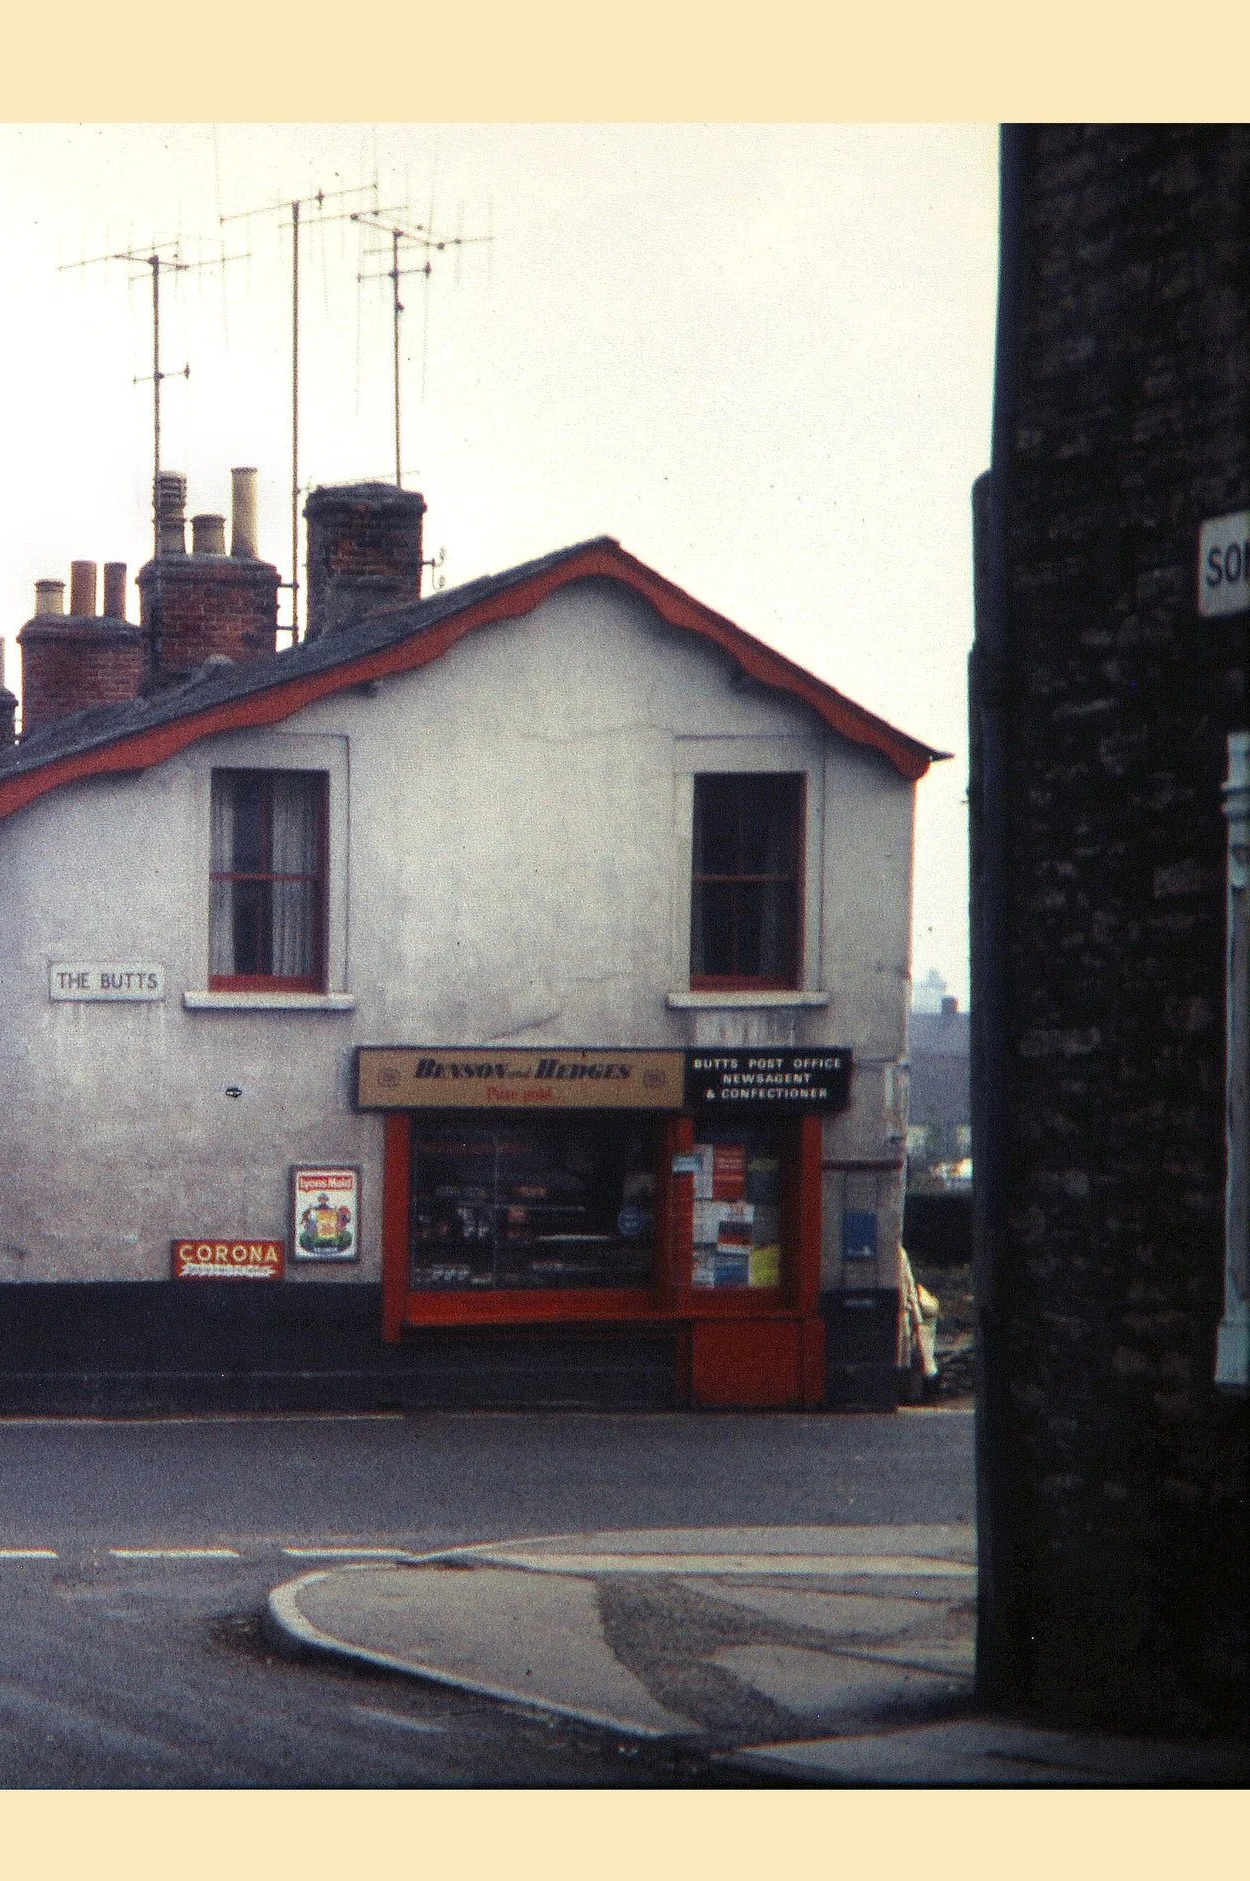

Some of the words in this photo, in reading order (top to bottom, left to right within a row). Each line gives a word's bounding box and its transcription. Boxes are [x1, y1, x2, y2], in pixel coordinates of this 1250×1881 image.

[57, 972, 90, 989] THE
[100, 972, 159, 989] BUTTS
[415, 1058, 509, 1079] BENSON
[534, 1058, 631, 1079] HEDGES
[693, 1058, 738, 1069] BUTTS
[749, 1058, 784, 1069] POST
[793, 1058, 842, 1069] OFFICE
[722, 1072, 811, 1084] NEWSAGENT
[706, 1087, 716, 1099] &
[721, 1087, 828, 1099] CONFECTIONER
[179, 1244, 279, 1264] CORONA
